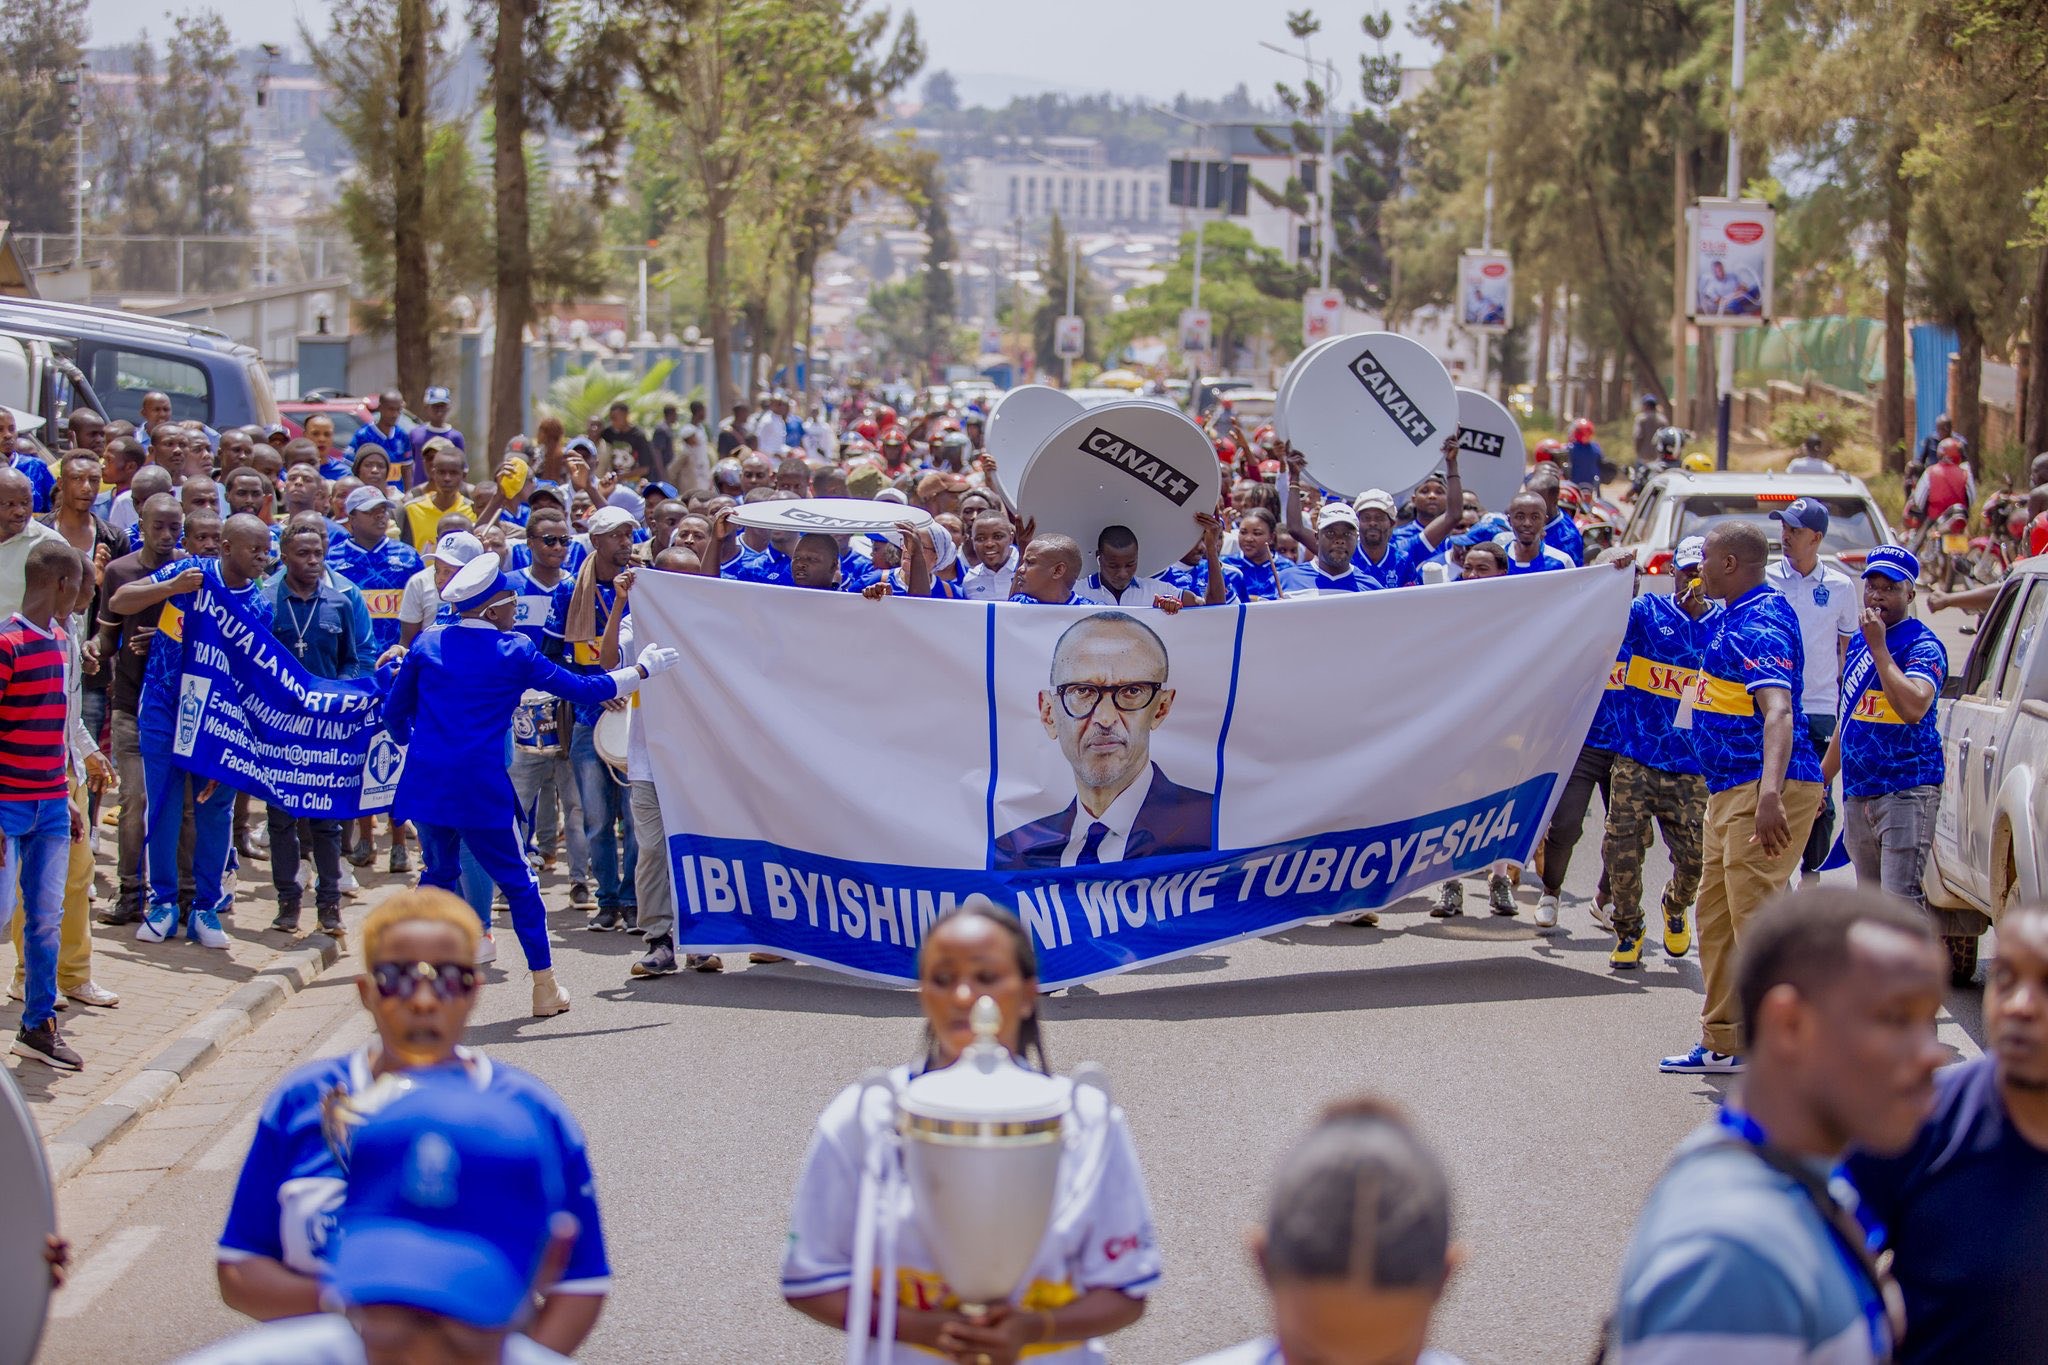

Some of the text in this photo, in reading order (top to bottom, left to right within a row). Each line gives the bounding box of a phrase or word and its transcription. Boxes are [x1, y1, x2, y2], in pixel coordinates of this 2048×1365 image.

[1356, 357, 1428, 438] CANAL+
[1088, 433, 1189, 496] CANAL+
[253, 643, 278, 677] LA
[280, 667, 338, 713] MORT
[302, 792, 332, 810] Club
[682, 854, 752, 915] IBI
[1015, 884, 1073, 950] NI
[1077, 866, 1222, 938] WOWE
[1236, 799, 1520, 902] TUBICYESHA.
